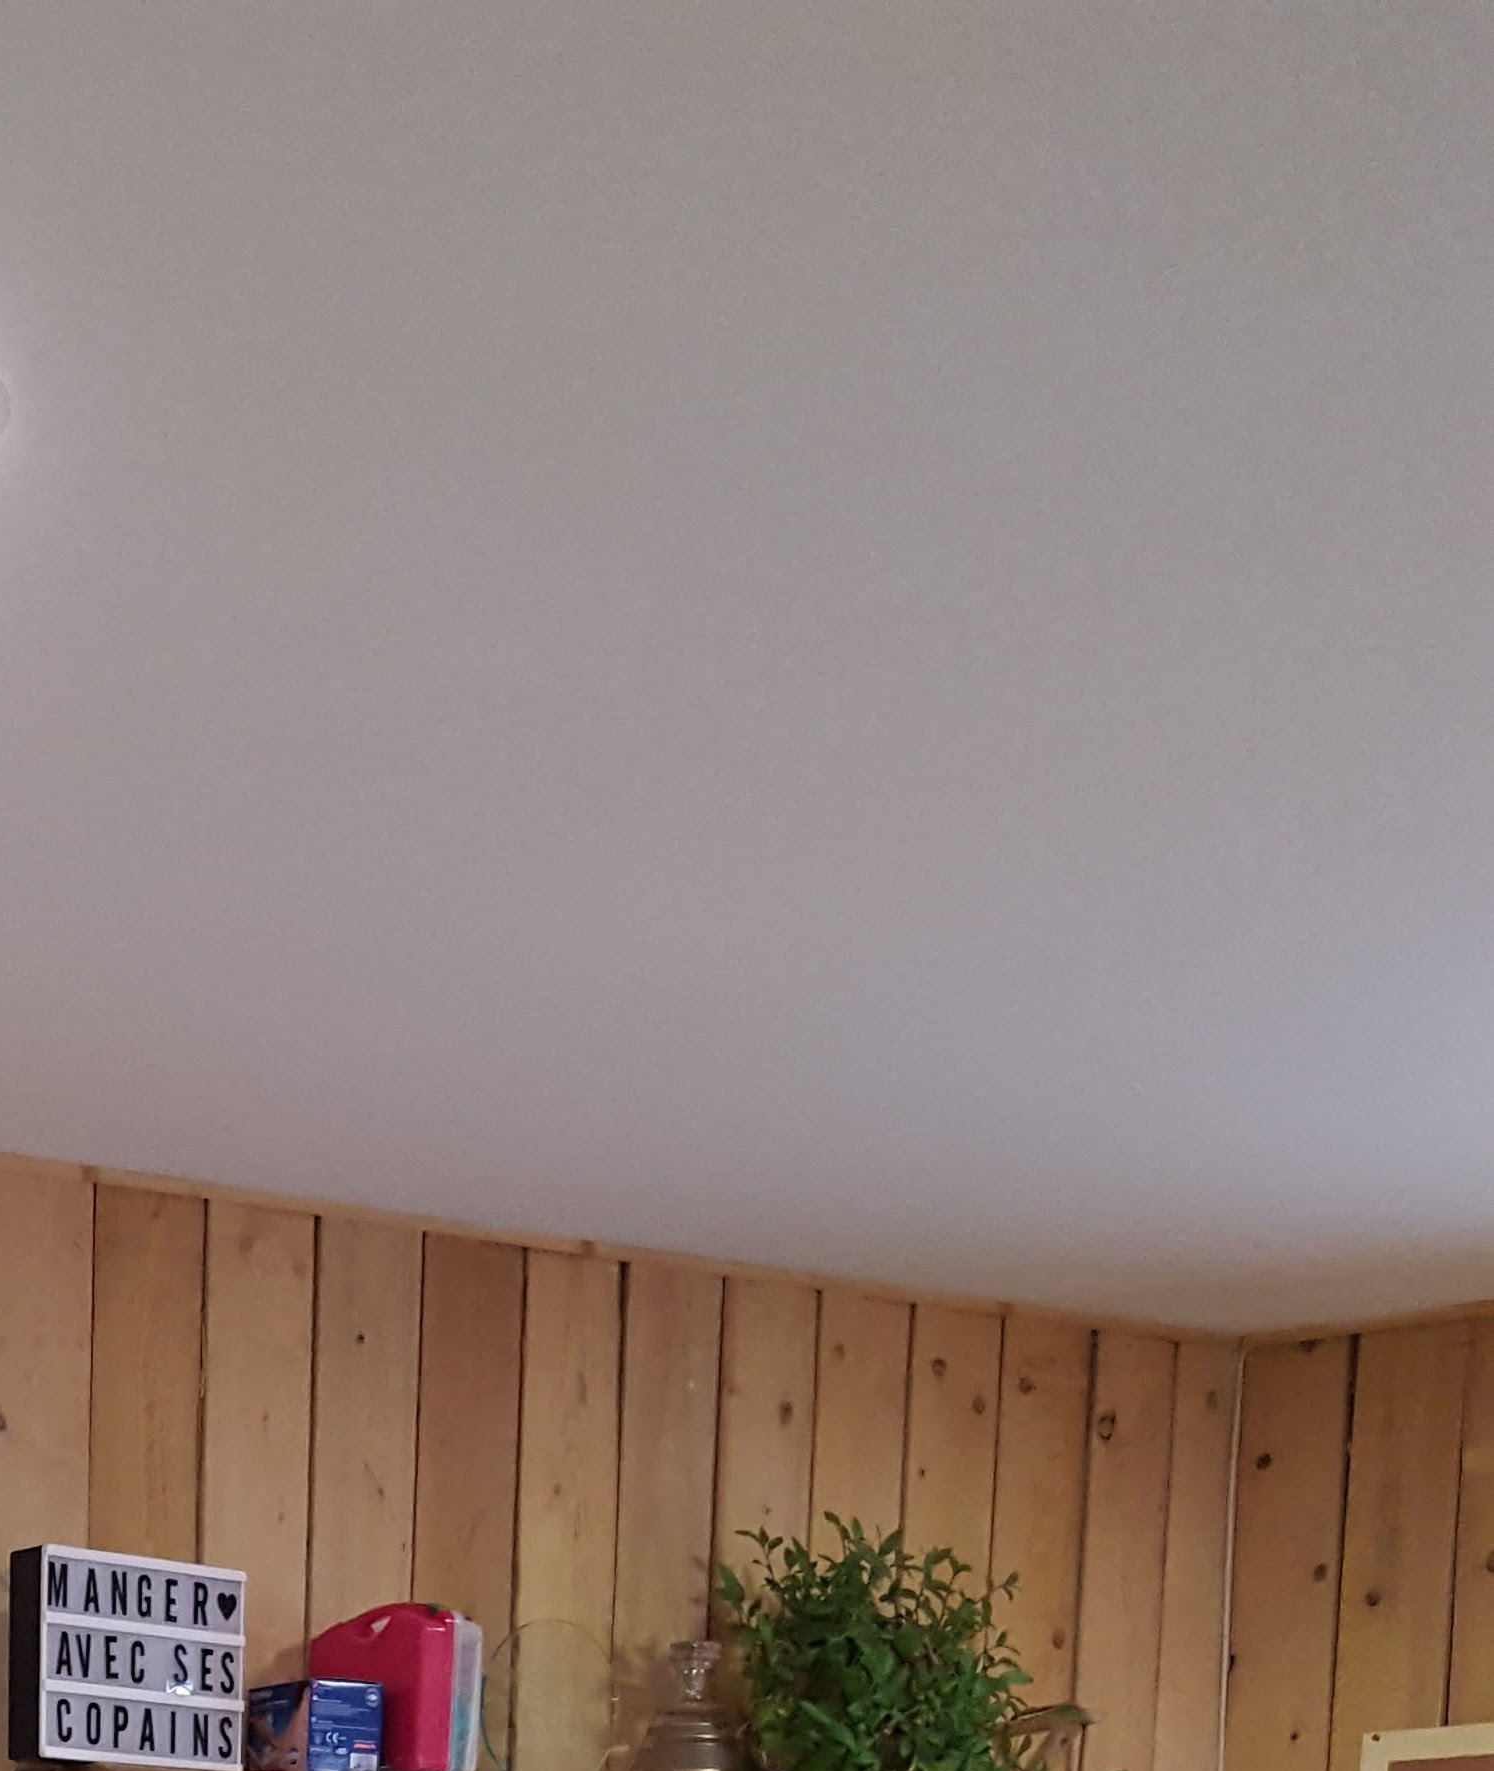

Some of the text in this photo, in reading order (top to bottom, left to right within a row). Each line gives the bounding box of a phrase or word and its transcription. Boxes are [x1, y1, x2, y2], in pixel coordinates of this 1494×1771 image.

[47, 1561, 208, 1626] MANGER
[56, 1631, 235, 1694] AVEC SES
[56, 1699, 233, 1759] COPAINS
